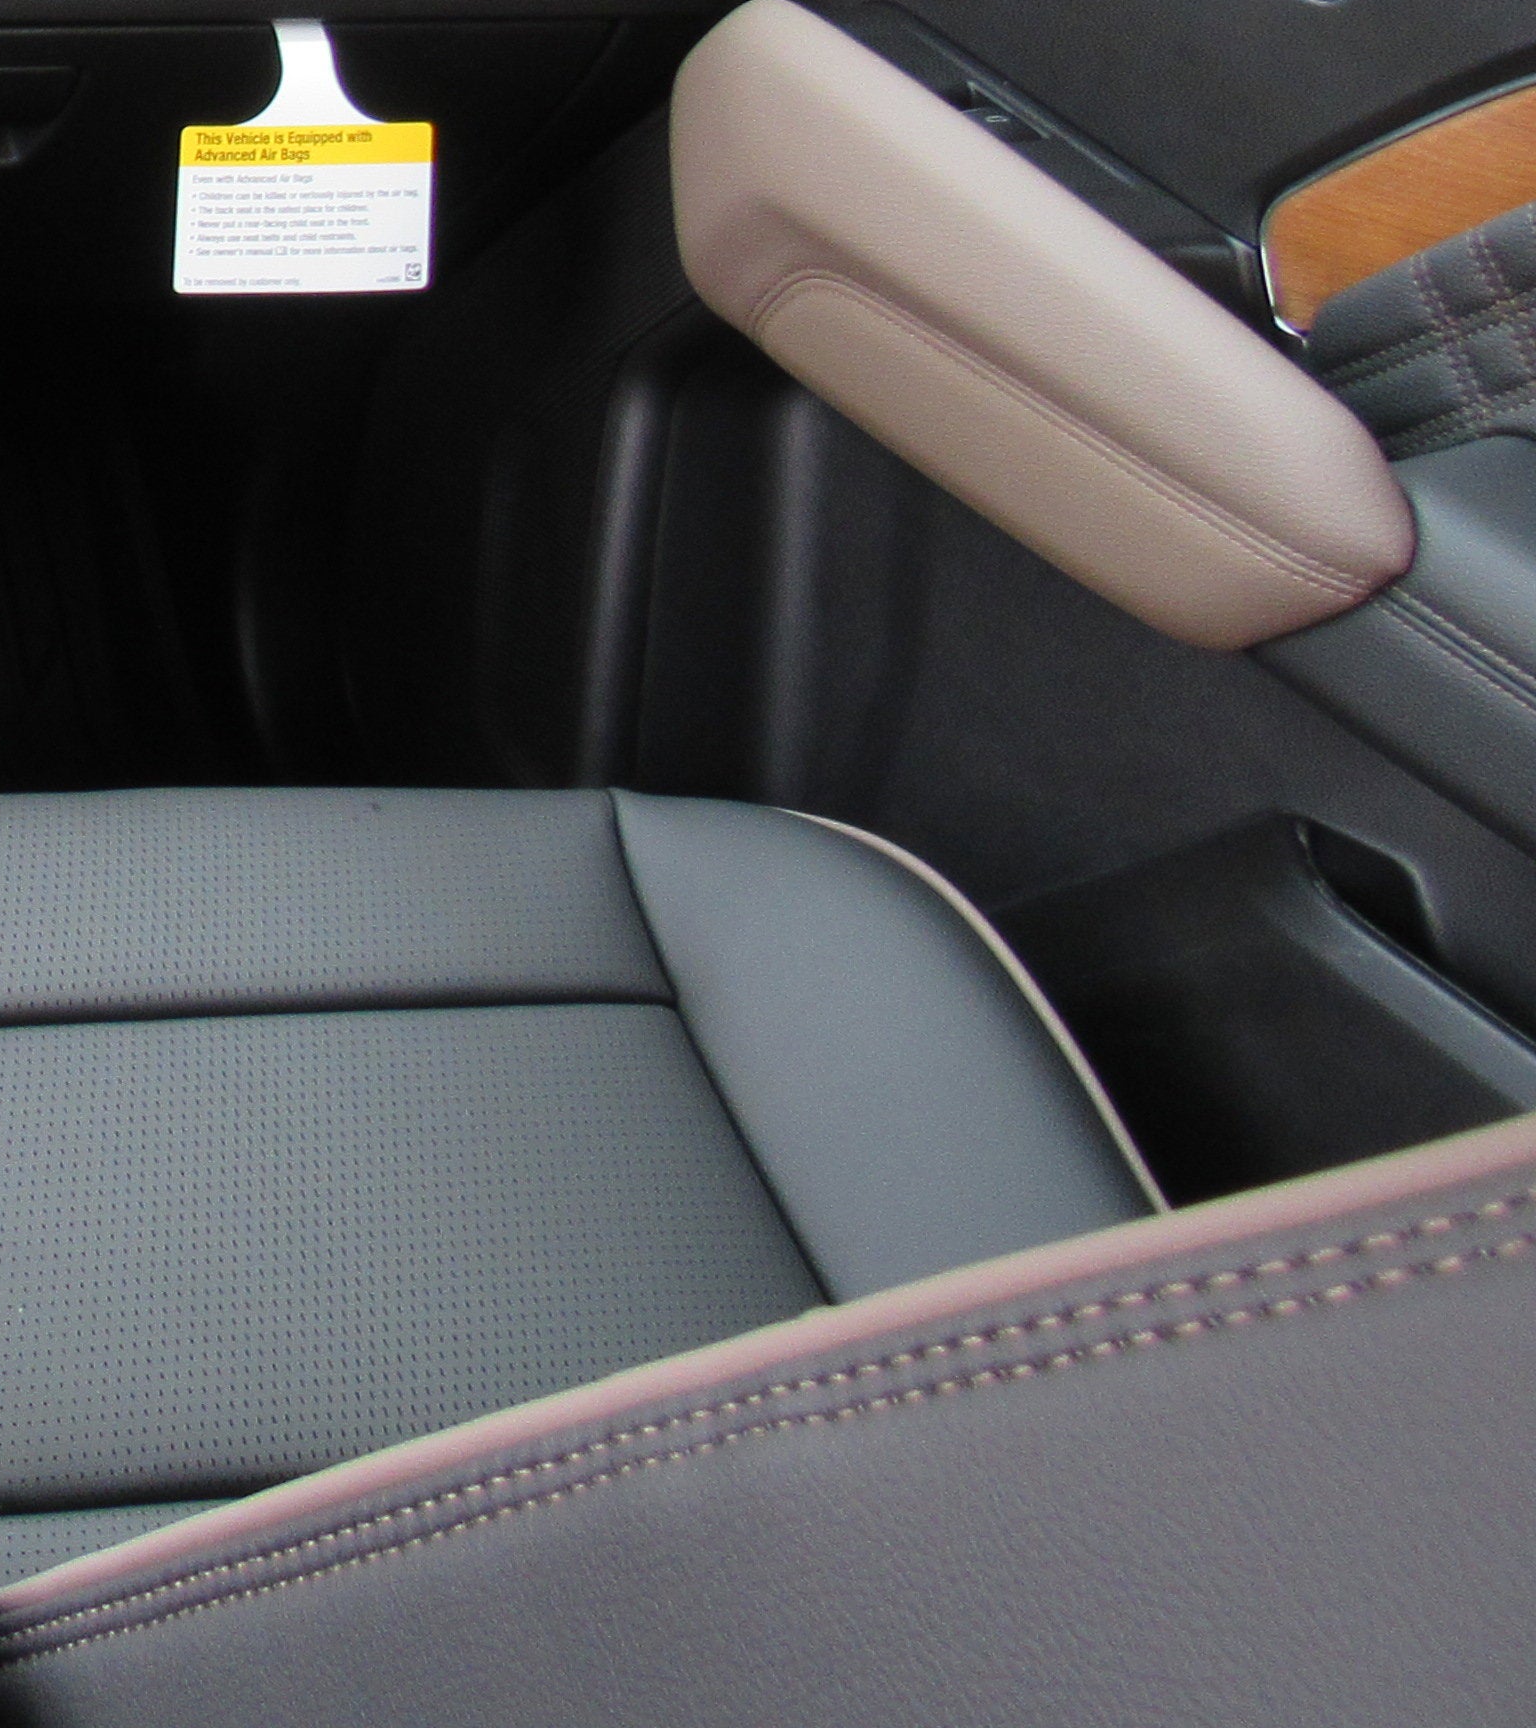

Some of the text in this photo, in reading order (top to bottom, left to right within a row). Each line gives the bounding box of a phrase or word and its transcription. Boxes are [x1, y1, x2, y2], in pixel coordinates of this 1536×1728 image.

[196, 130, 373, 146] This Vehicle is Equipped with
[194, 148, 310, 163] Advanced Air Bags
